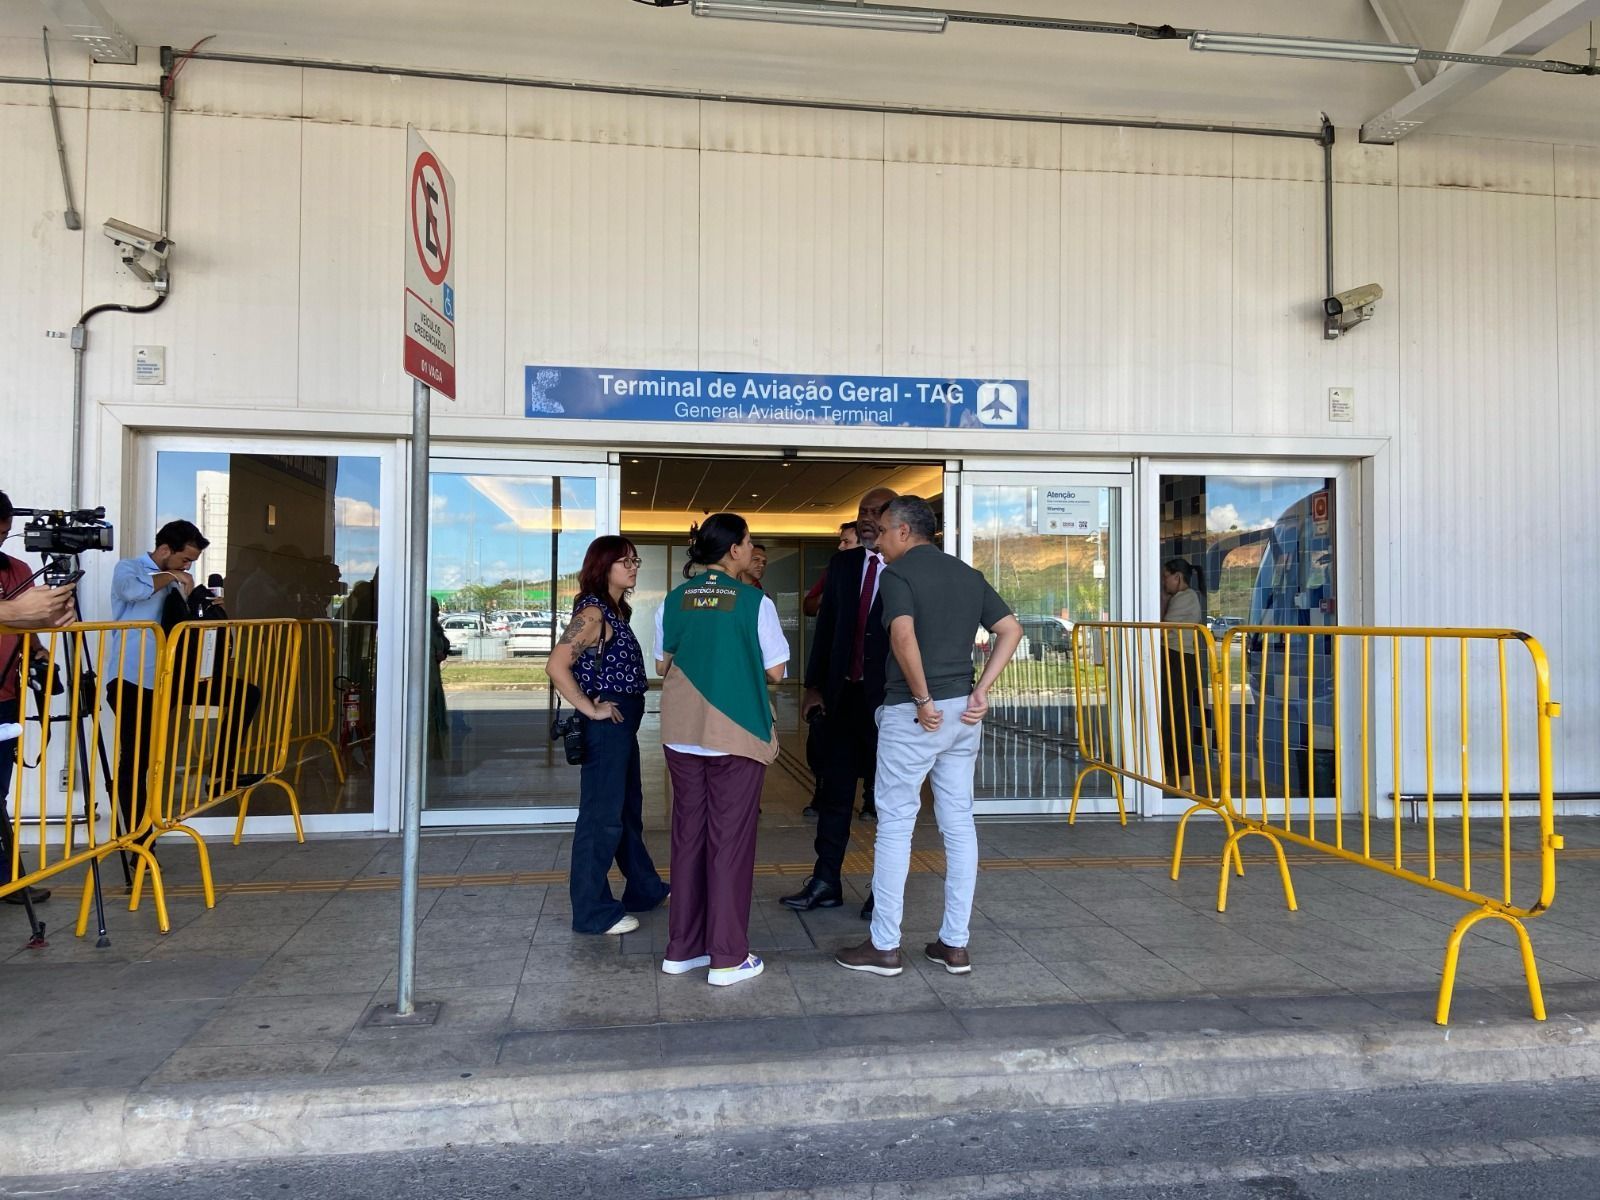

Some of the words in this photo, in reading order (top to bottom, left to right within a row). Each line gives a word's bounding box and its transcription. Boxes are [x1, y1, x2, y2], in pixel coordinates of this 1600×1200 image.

[420, 311, 441, 337] VEÍCULOS
[413, 322, 447, 355] CREDENCIADOS
[421, 359, 428, 373] 01
[428, 363, 443, 384] VAGA
[599, 374, 701, 398] Terminal
[708, 378, 737, 398] de
[742, 379, 833, 405] Aviação
[838, 381, 898, 403] Geral
[916, 384, 964, 404] TAG
[674, 401, 742, 419] General
[748, 403, 815, 420] Aviation
[820, 405, 893, 422] Terminal
[1047, 491, 1076, 499] Atenção
